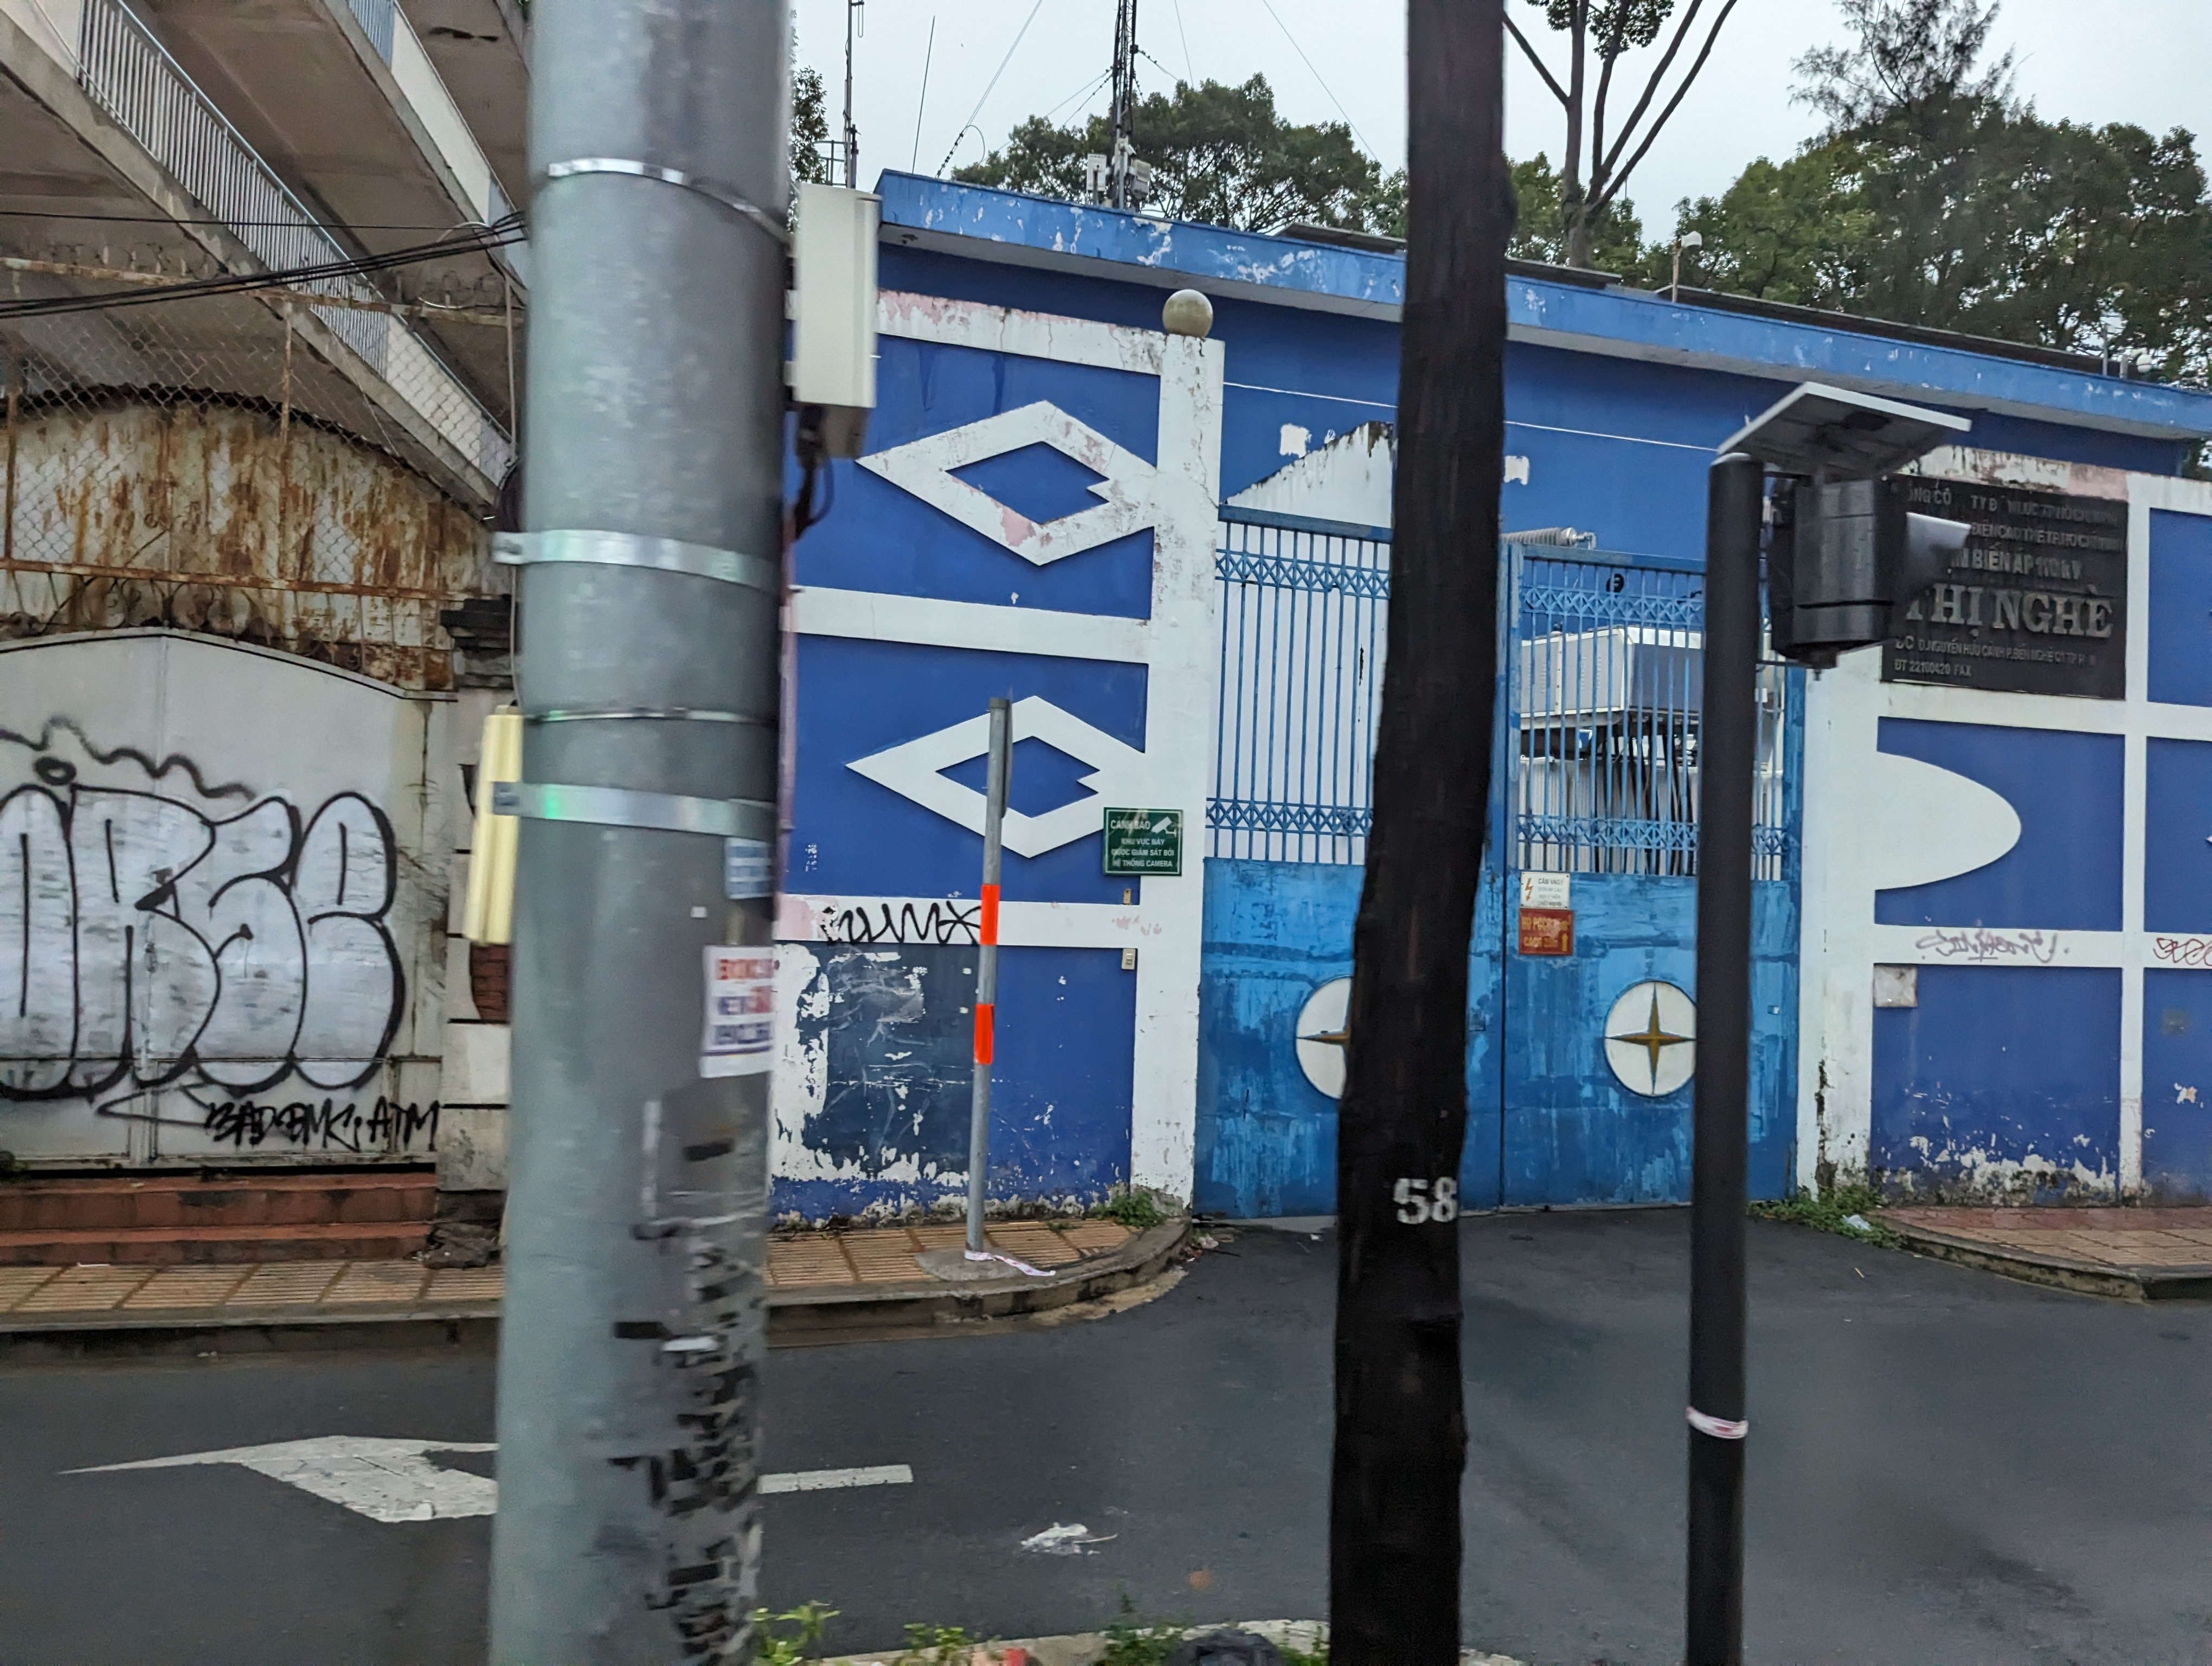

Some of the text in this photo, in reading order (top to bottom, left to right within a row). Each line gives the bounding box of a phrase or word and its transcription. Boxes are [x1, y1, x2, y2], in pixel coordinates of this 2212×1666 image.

[1953, 664, 1972, 677] FAX
[1149, 848, 1162, 856] SÁT
[1163, 847, 1174, 856] BỞI
[1122, 857, 1145, 867] THỐNG
[1393, 1176, 1457, 1225] 58
